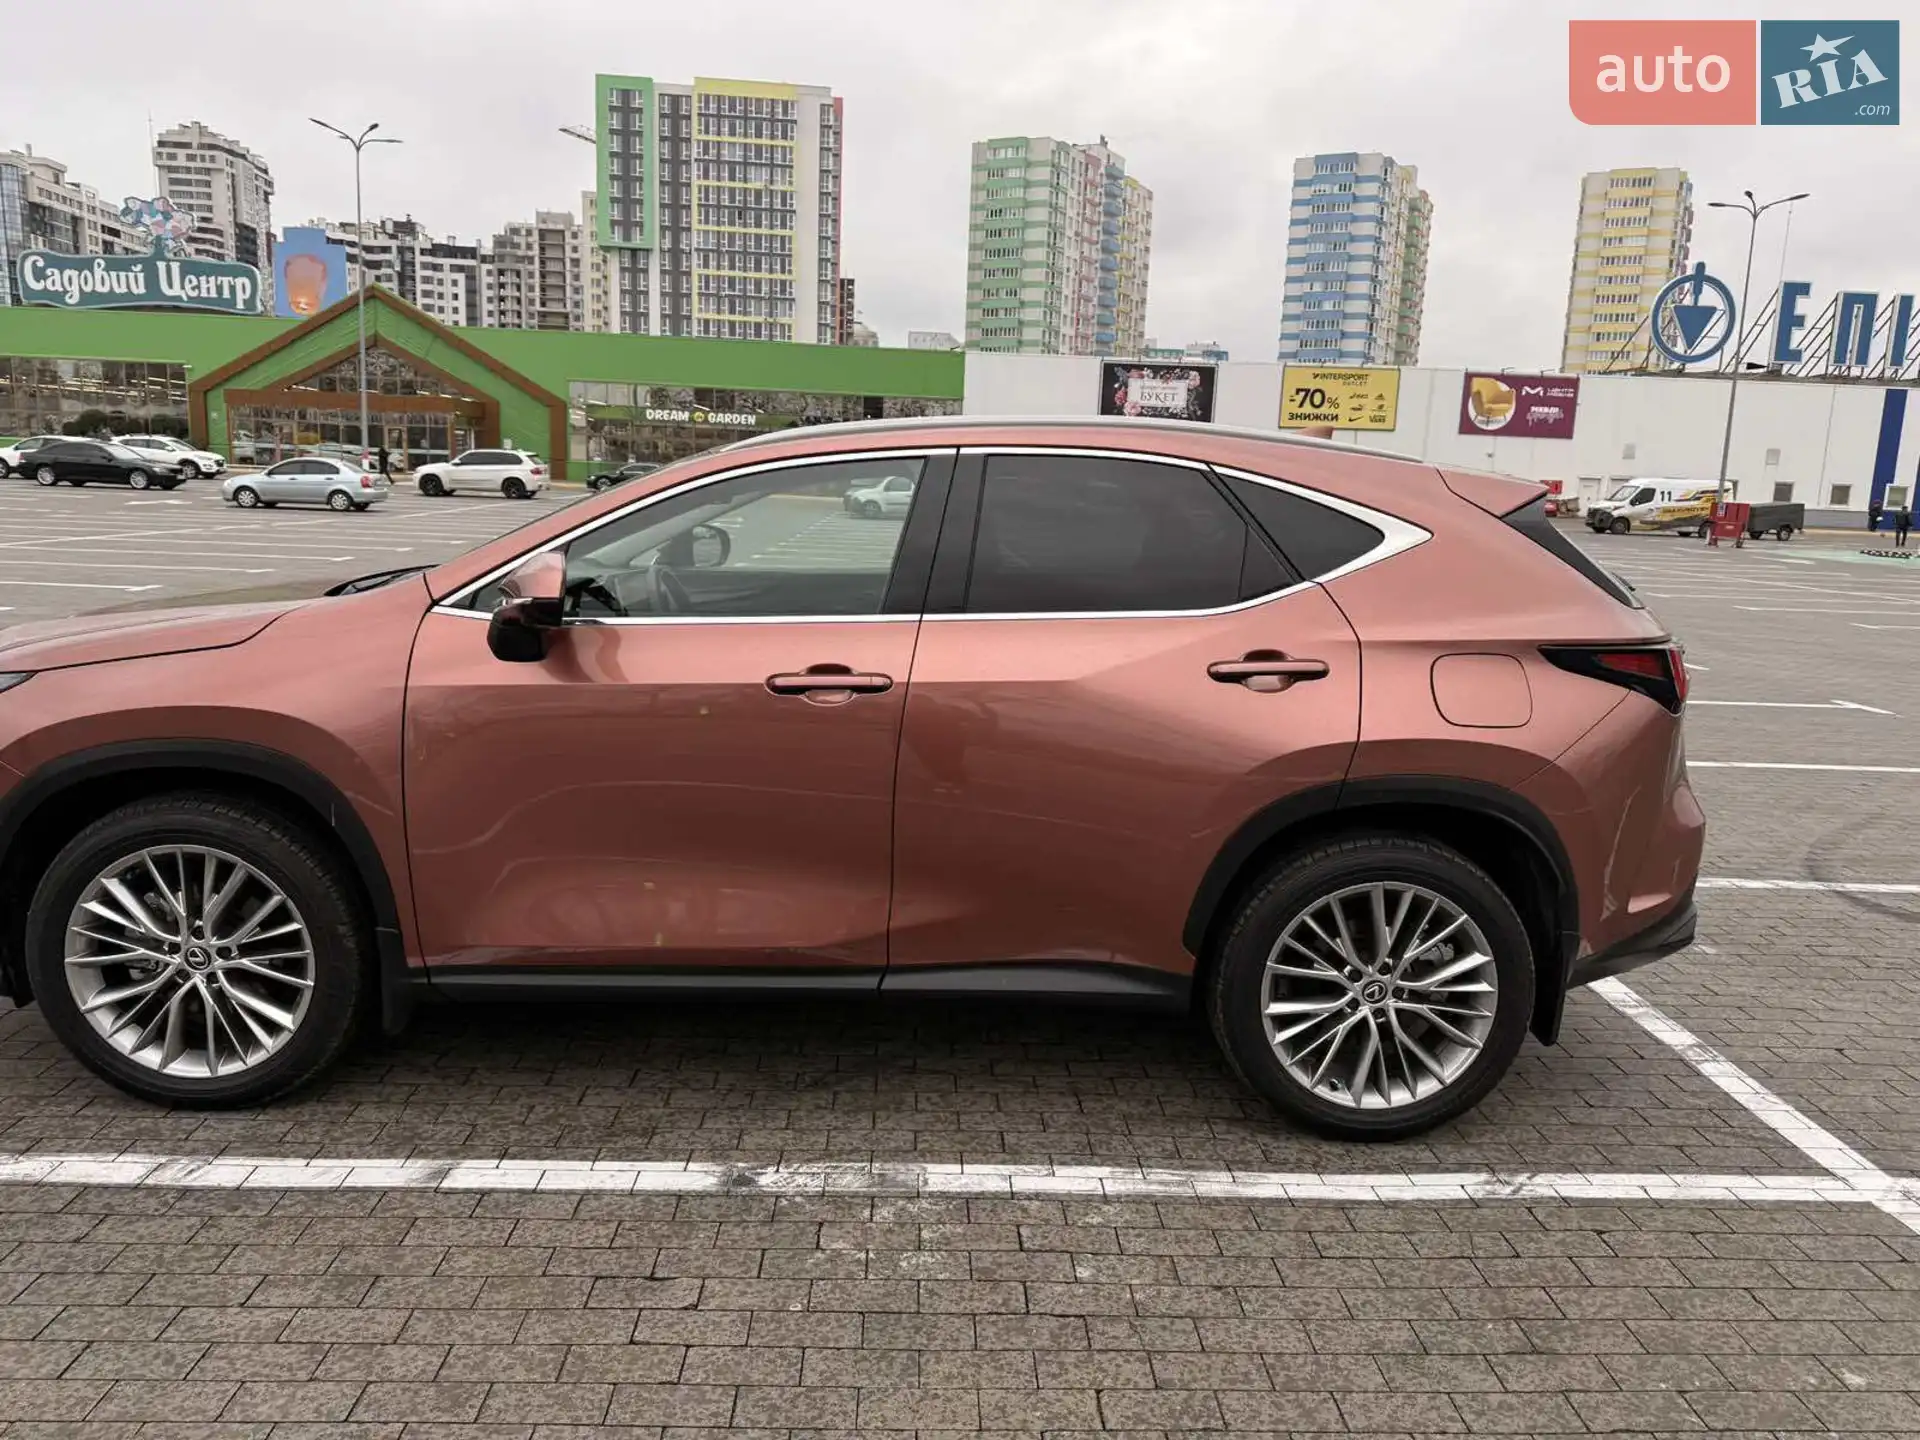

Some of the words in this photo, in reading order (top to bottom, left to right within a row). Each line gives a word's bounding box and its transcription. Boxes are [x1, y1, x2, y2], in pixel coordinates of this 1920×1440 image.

[24, 255, 146, 305] Садовий
[156, 261, 252, 309] Центр
[1140, 391, 1178, 404] БУКЕТ
[646, 409, 690, 421] DREAM
[708, 412, 756, 425] GARDEN
[1288, 412, 1339, 422] ЗНИЖКИ
[1660, 490, 1672, 502] 11
